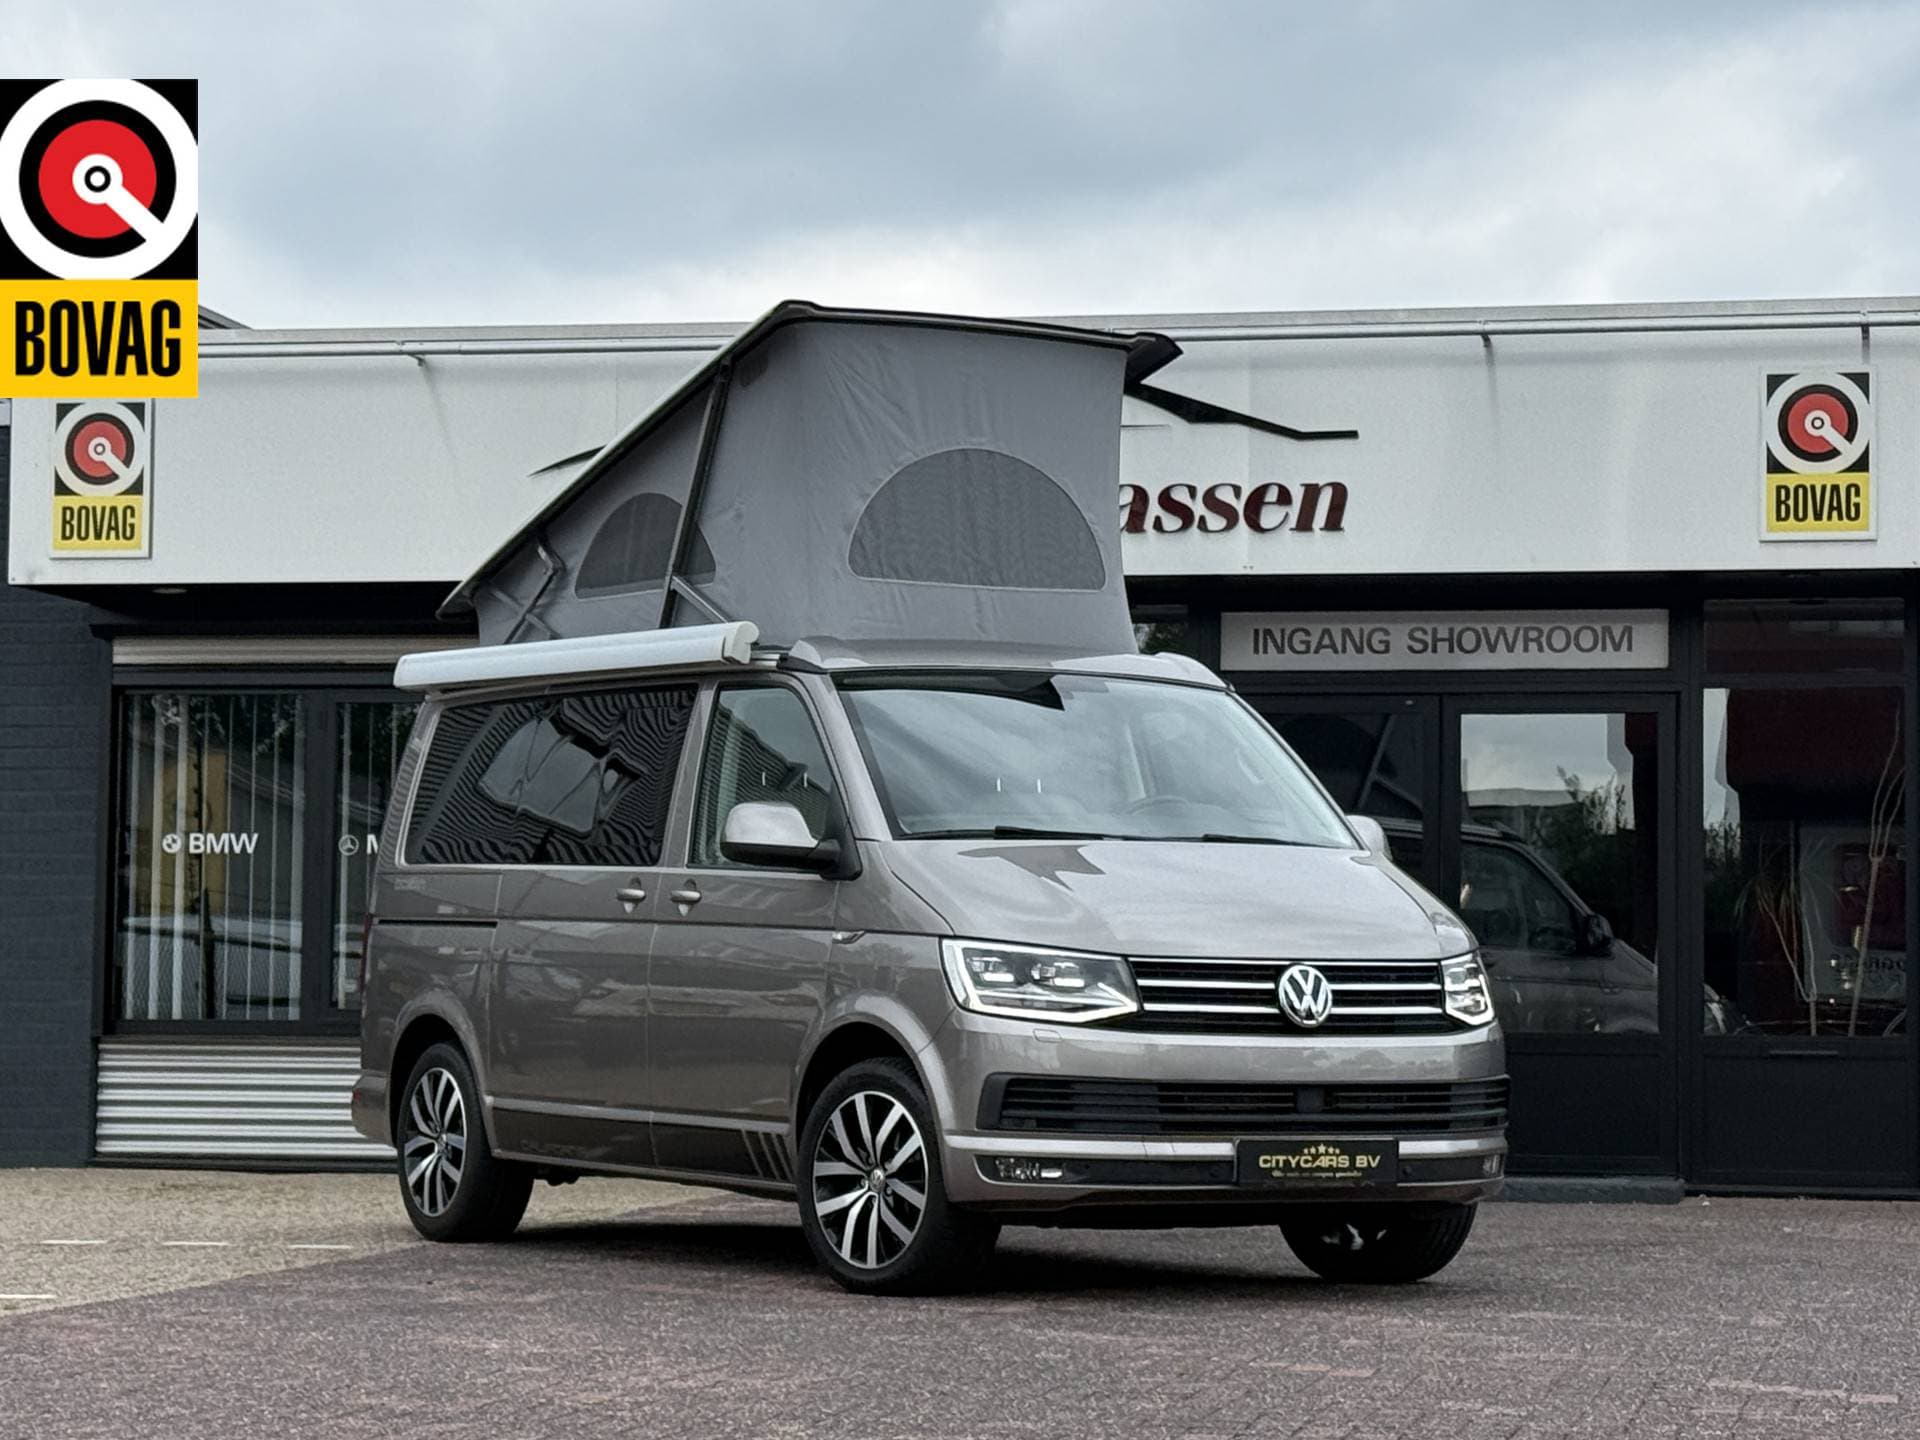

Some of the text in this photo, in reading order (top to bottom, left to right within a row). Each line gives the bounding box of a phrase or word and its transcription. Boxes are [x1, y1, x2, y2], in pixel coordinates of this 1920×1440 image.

[1775, 484, 1861, 522] BOVAG
[61, 506, 136, 541] BOVAG
[1253, 625, 1634, 656] INGANG SHOWROOM
[188, 833, 259, 855] BMW
[1258, 1154, 1381, 1169] CITYCARS BV
